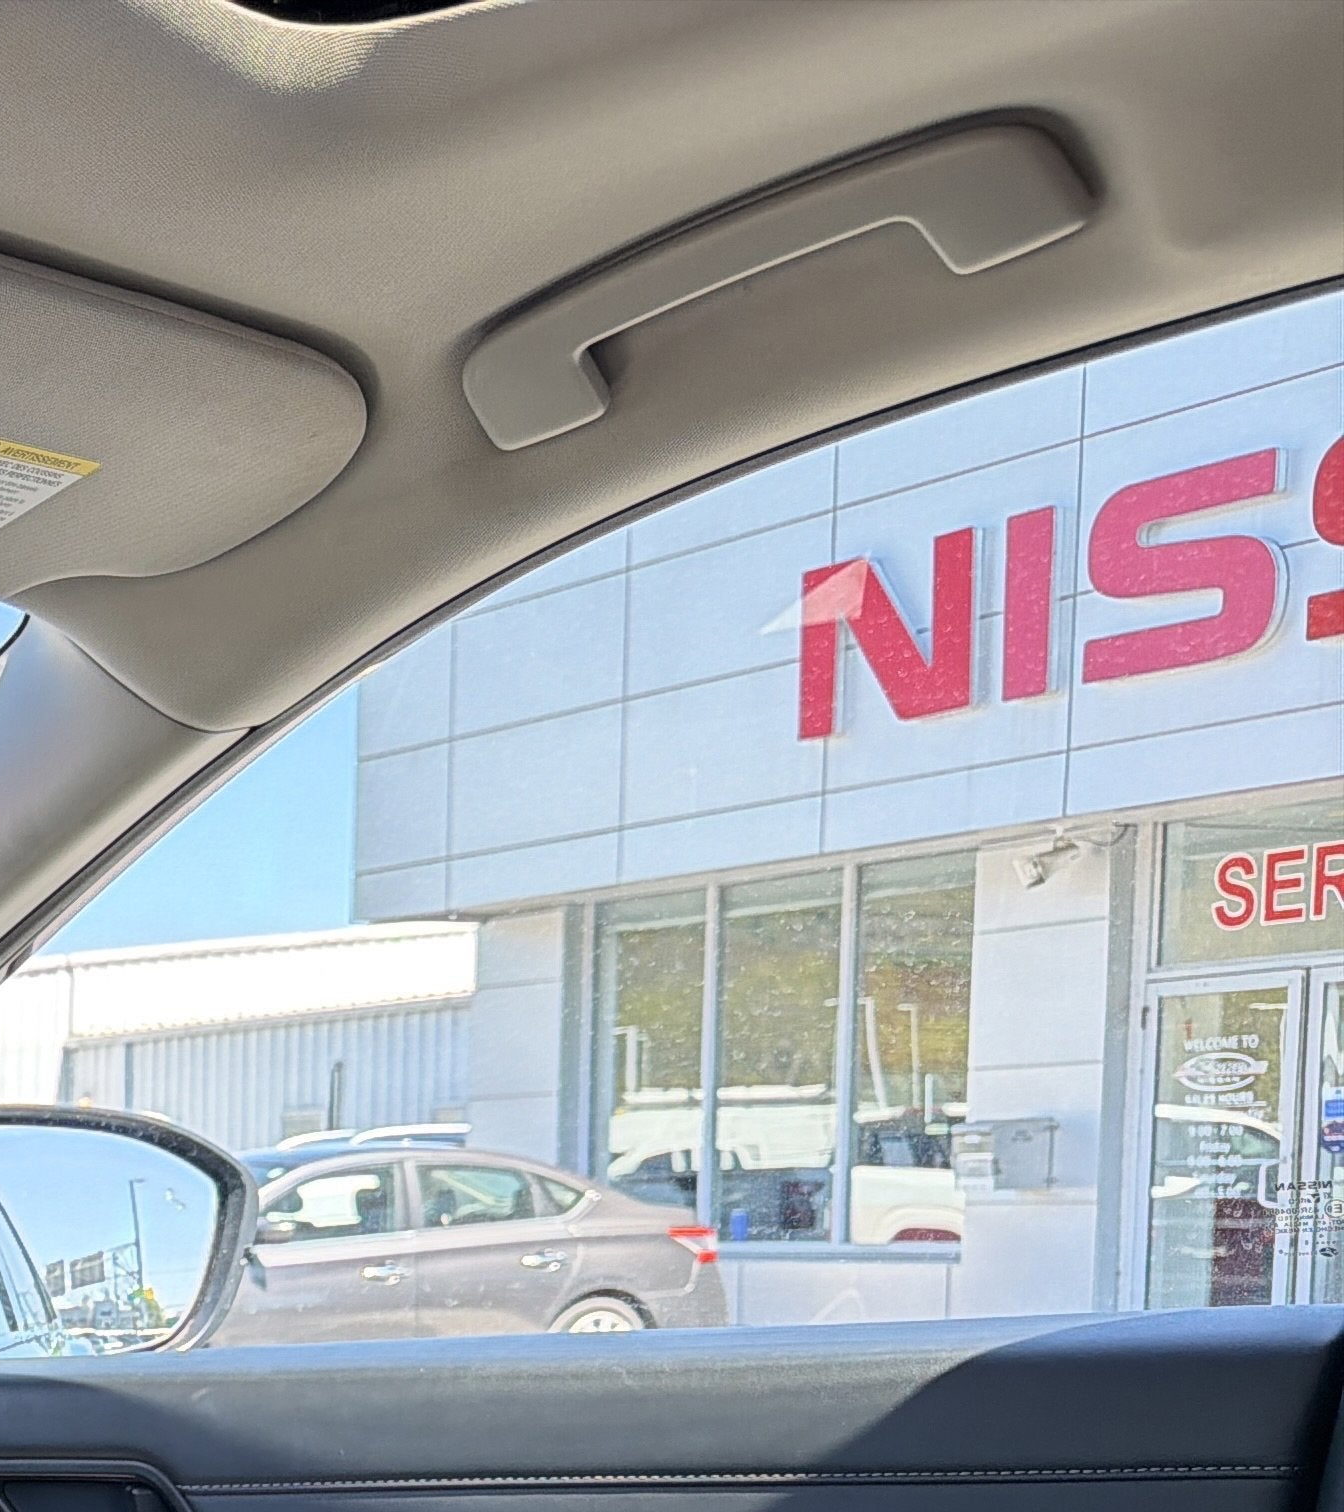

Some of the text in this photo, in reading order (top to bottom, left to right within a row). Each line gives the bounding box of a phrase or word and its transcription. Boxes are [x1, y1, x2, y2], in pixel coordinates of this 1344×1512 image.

[798, 434, 1344, 741] NIS
[1183, 1033, 1259, 1053] WELCOME TO
